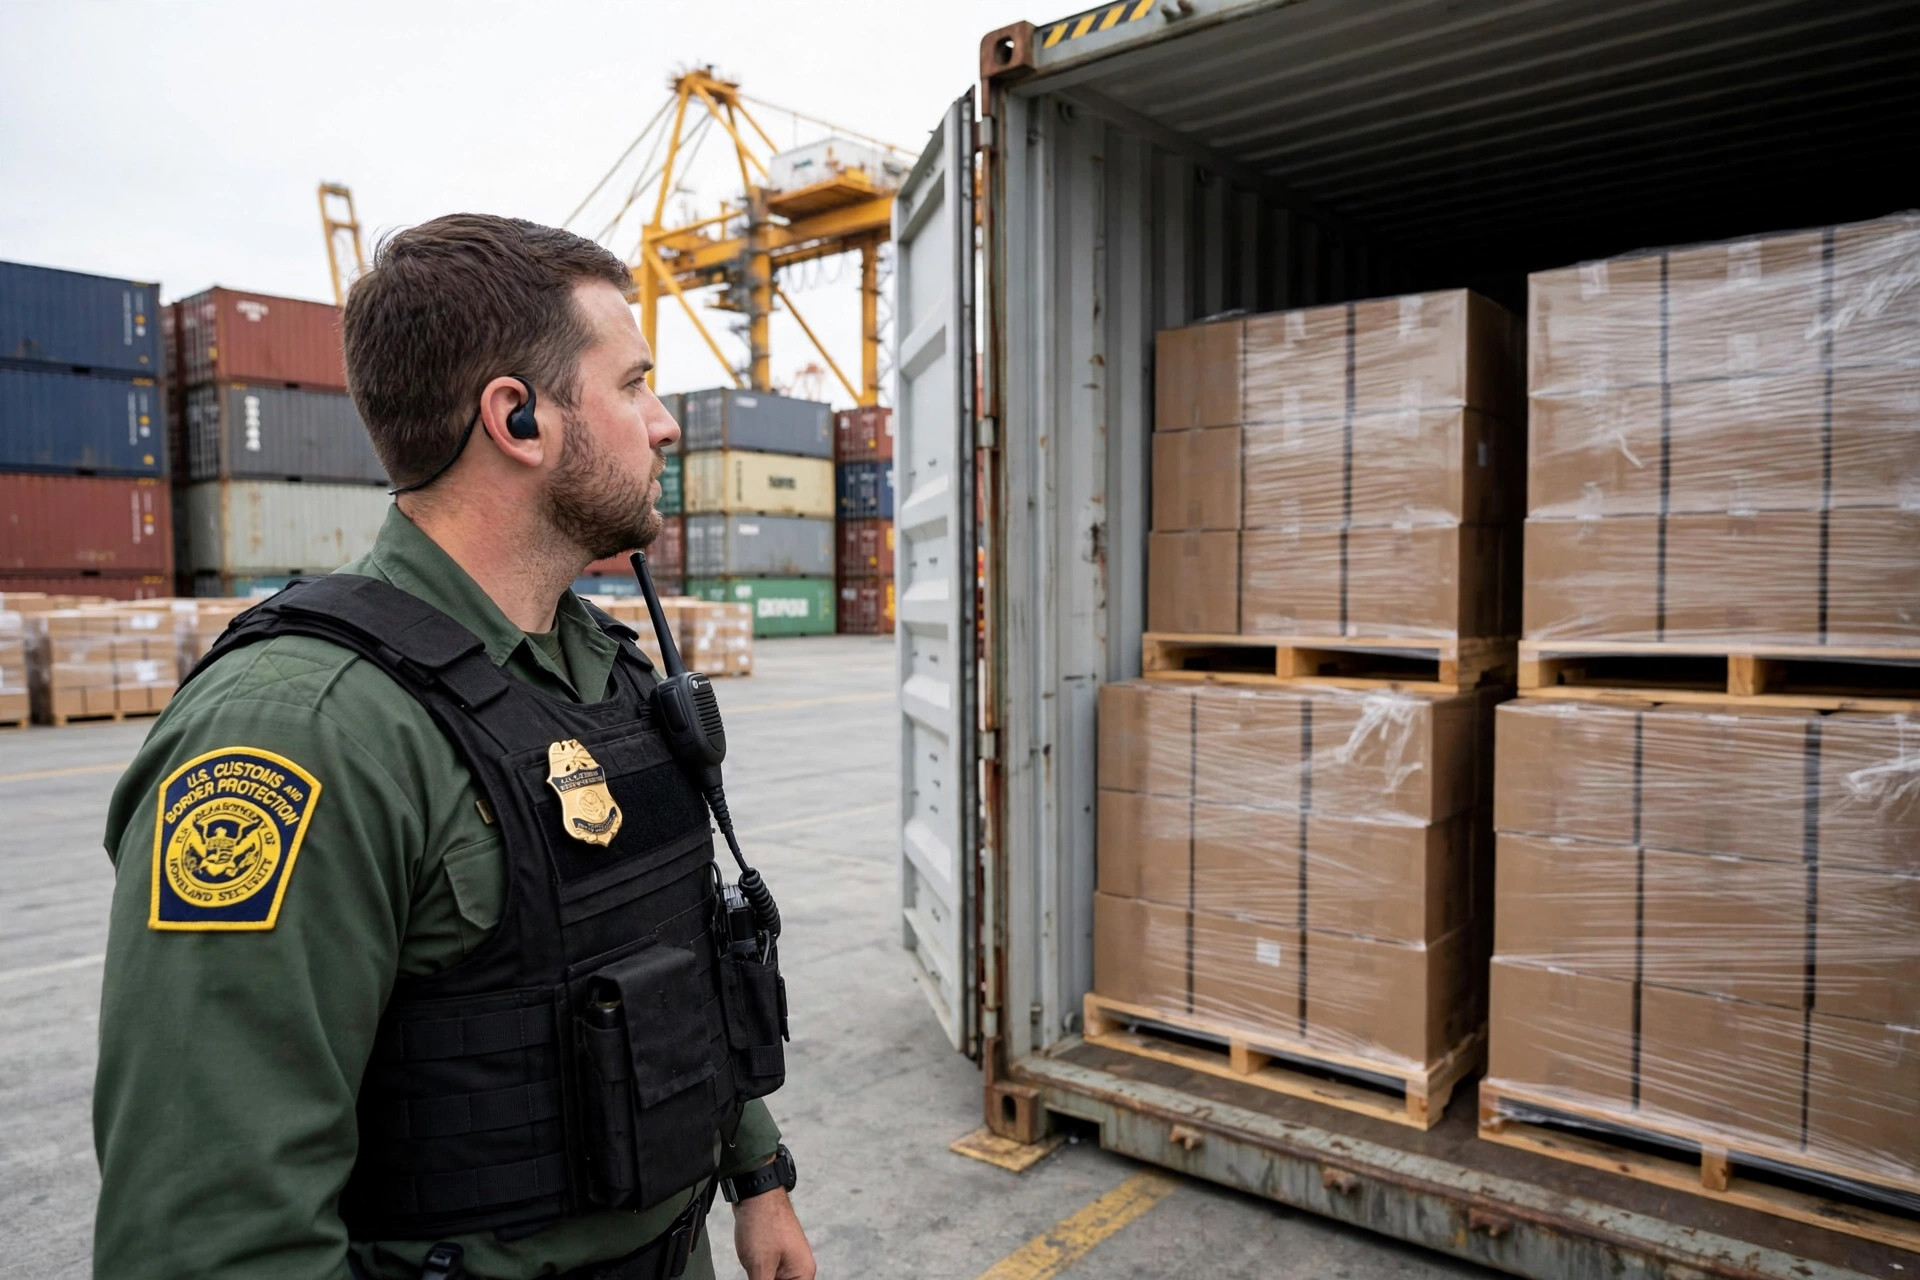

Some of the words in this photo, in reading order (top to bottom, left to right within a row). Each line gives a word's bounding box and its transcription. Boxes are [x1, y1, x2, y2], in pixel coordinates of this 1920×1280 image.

[213, 761, 285, 788] CUSTOMS
[283, 785, 304, 802] AND
[216, 777, 300, 826] PROTECTION
